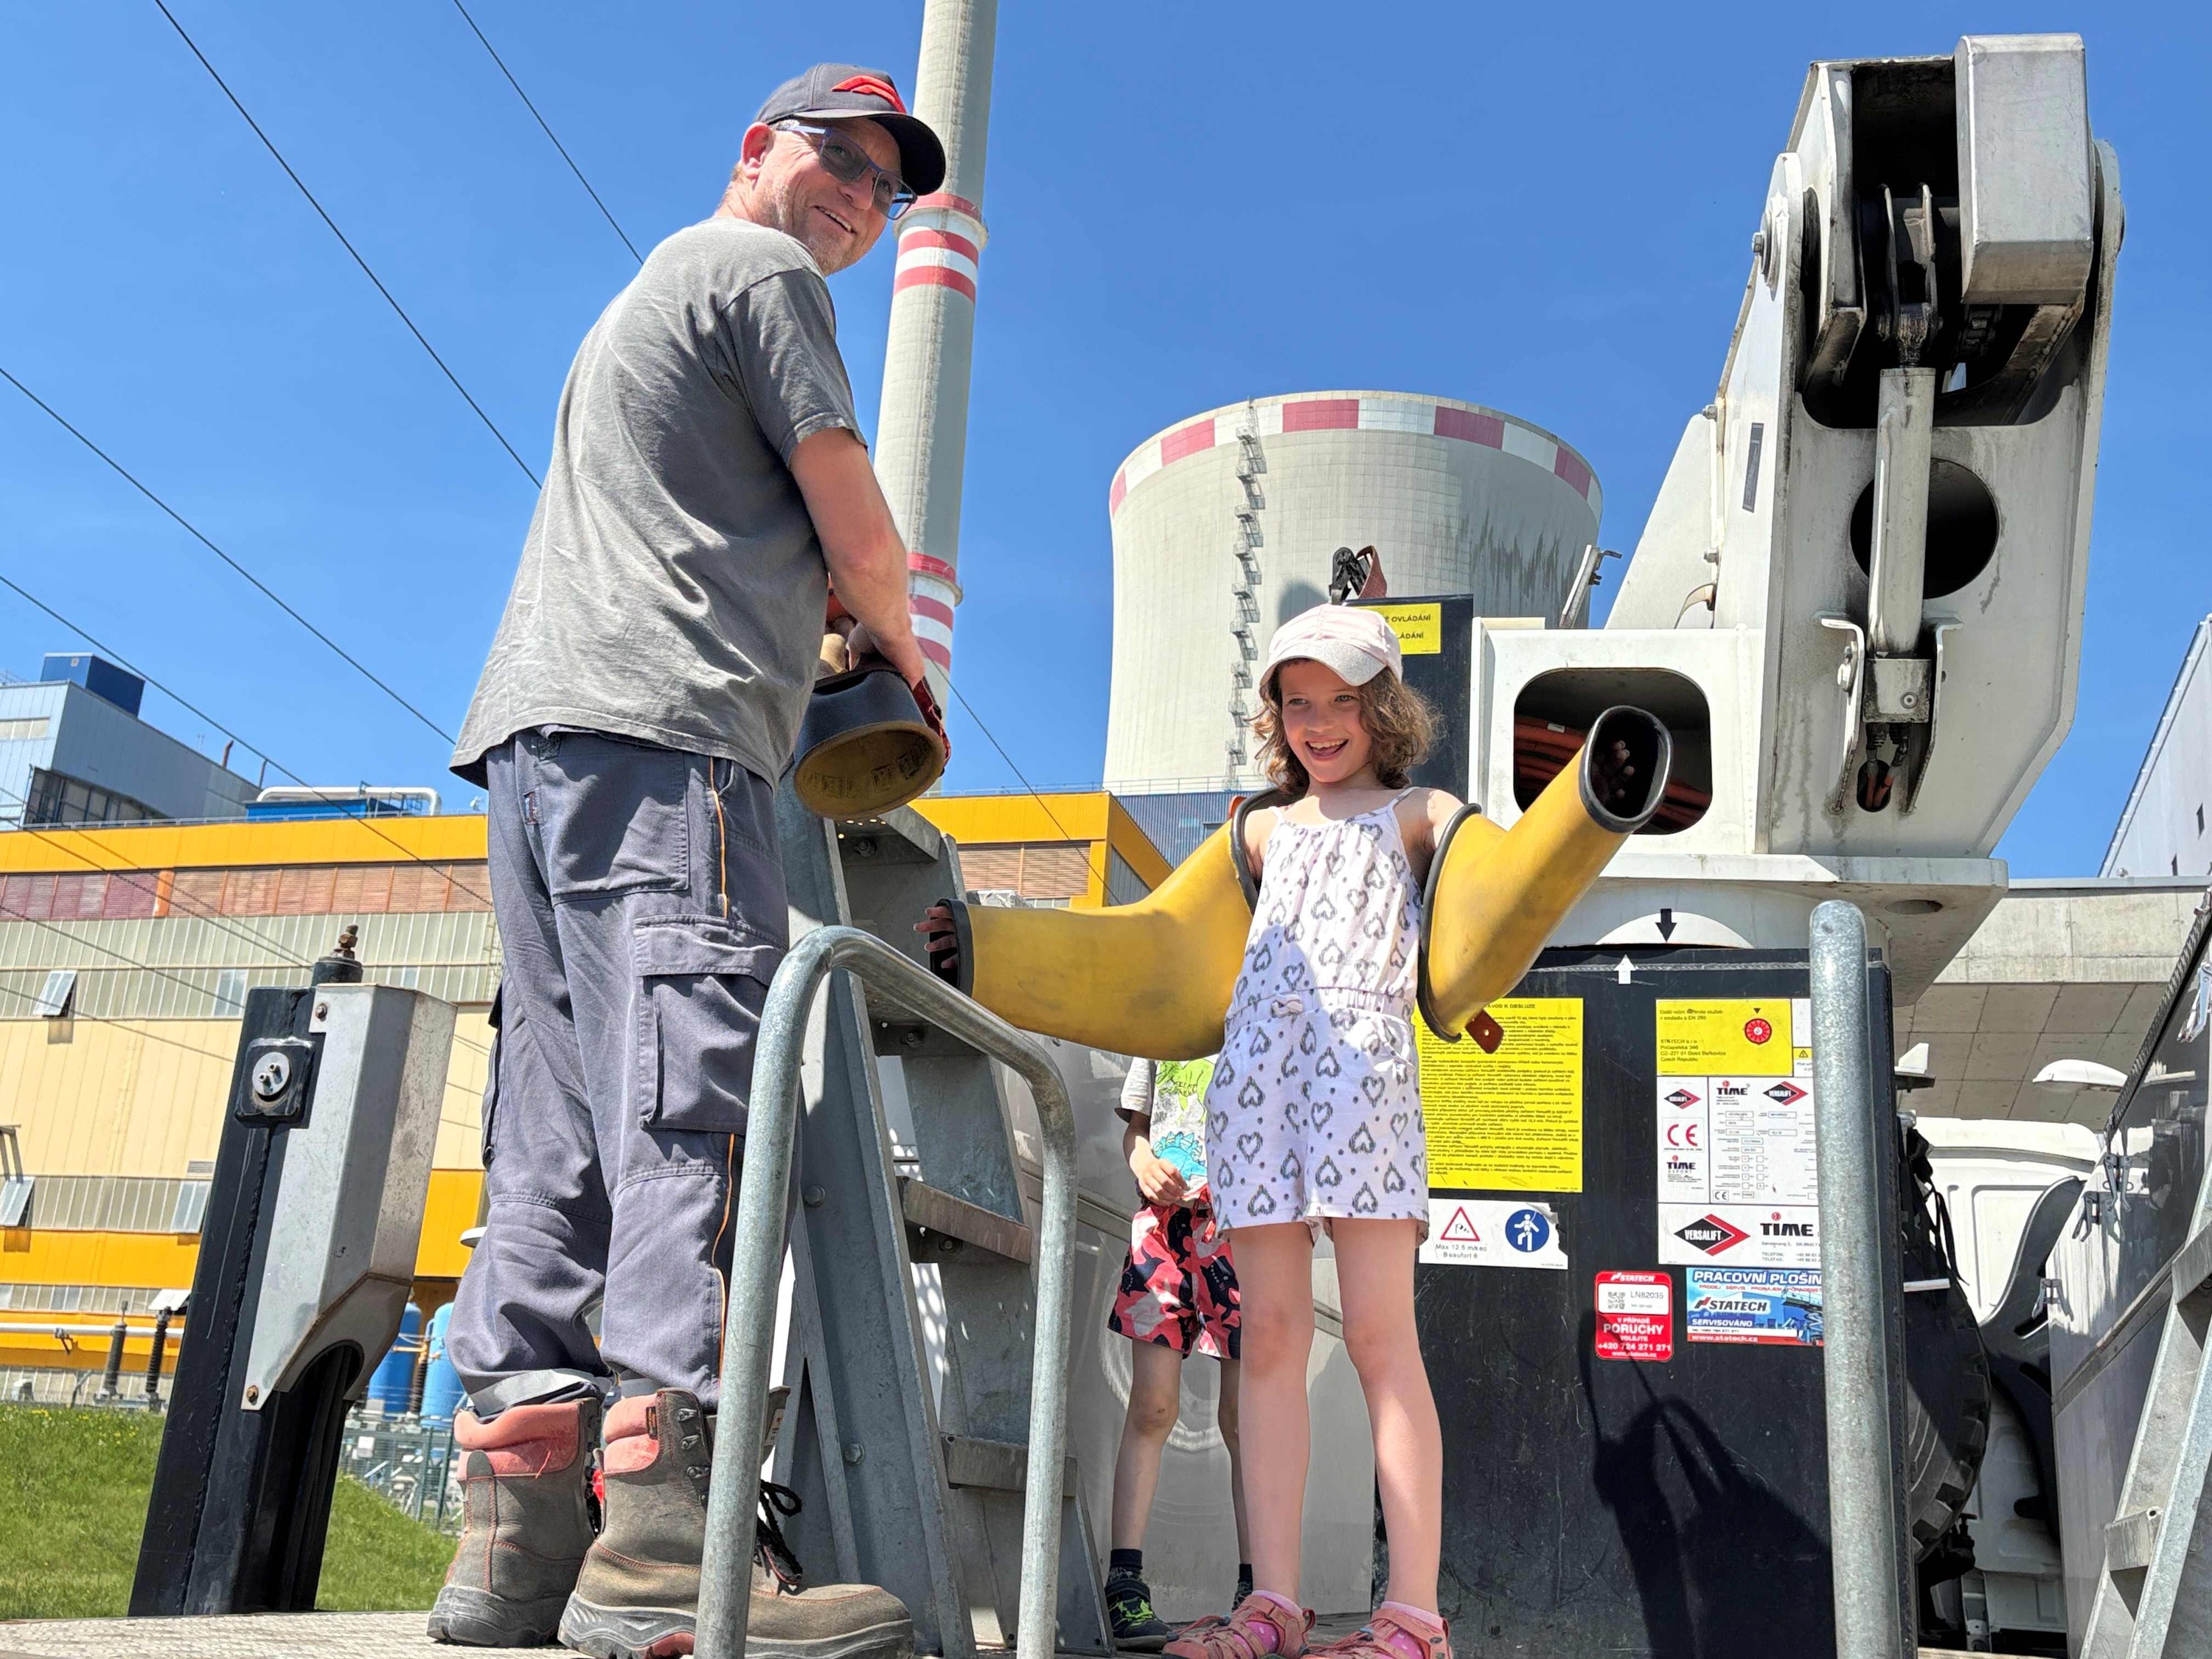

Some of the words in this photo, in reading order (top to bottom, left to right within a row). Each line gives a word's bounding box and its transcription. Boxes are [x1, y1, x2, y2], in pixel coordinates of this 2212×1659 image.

[1391, 613, 1431, 622] OVLÁDÁNÍ
[1684, 1229, 1722, 1241] VERSALIFT
[1619, 1274, 1655, 1282] STATECH
[1694, 1270, 1767, 1283] PRACOVNÍ
[1770, 1272, 1822, 1284] PLOŠIN
[1709, 1300, 1767, 1312] STATECH
[1691, 1318, 1753, 1327] SERVISOVÁNO
[1603, 1323, 1664, 1335] PORUCHY
[1597, 1342, 1618, 1350] +420
[1656, 1343, 1672, 1352] 271
